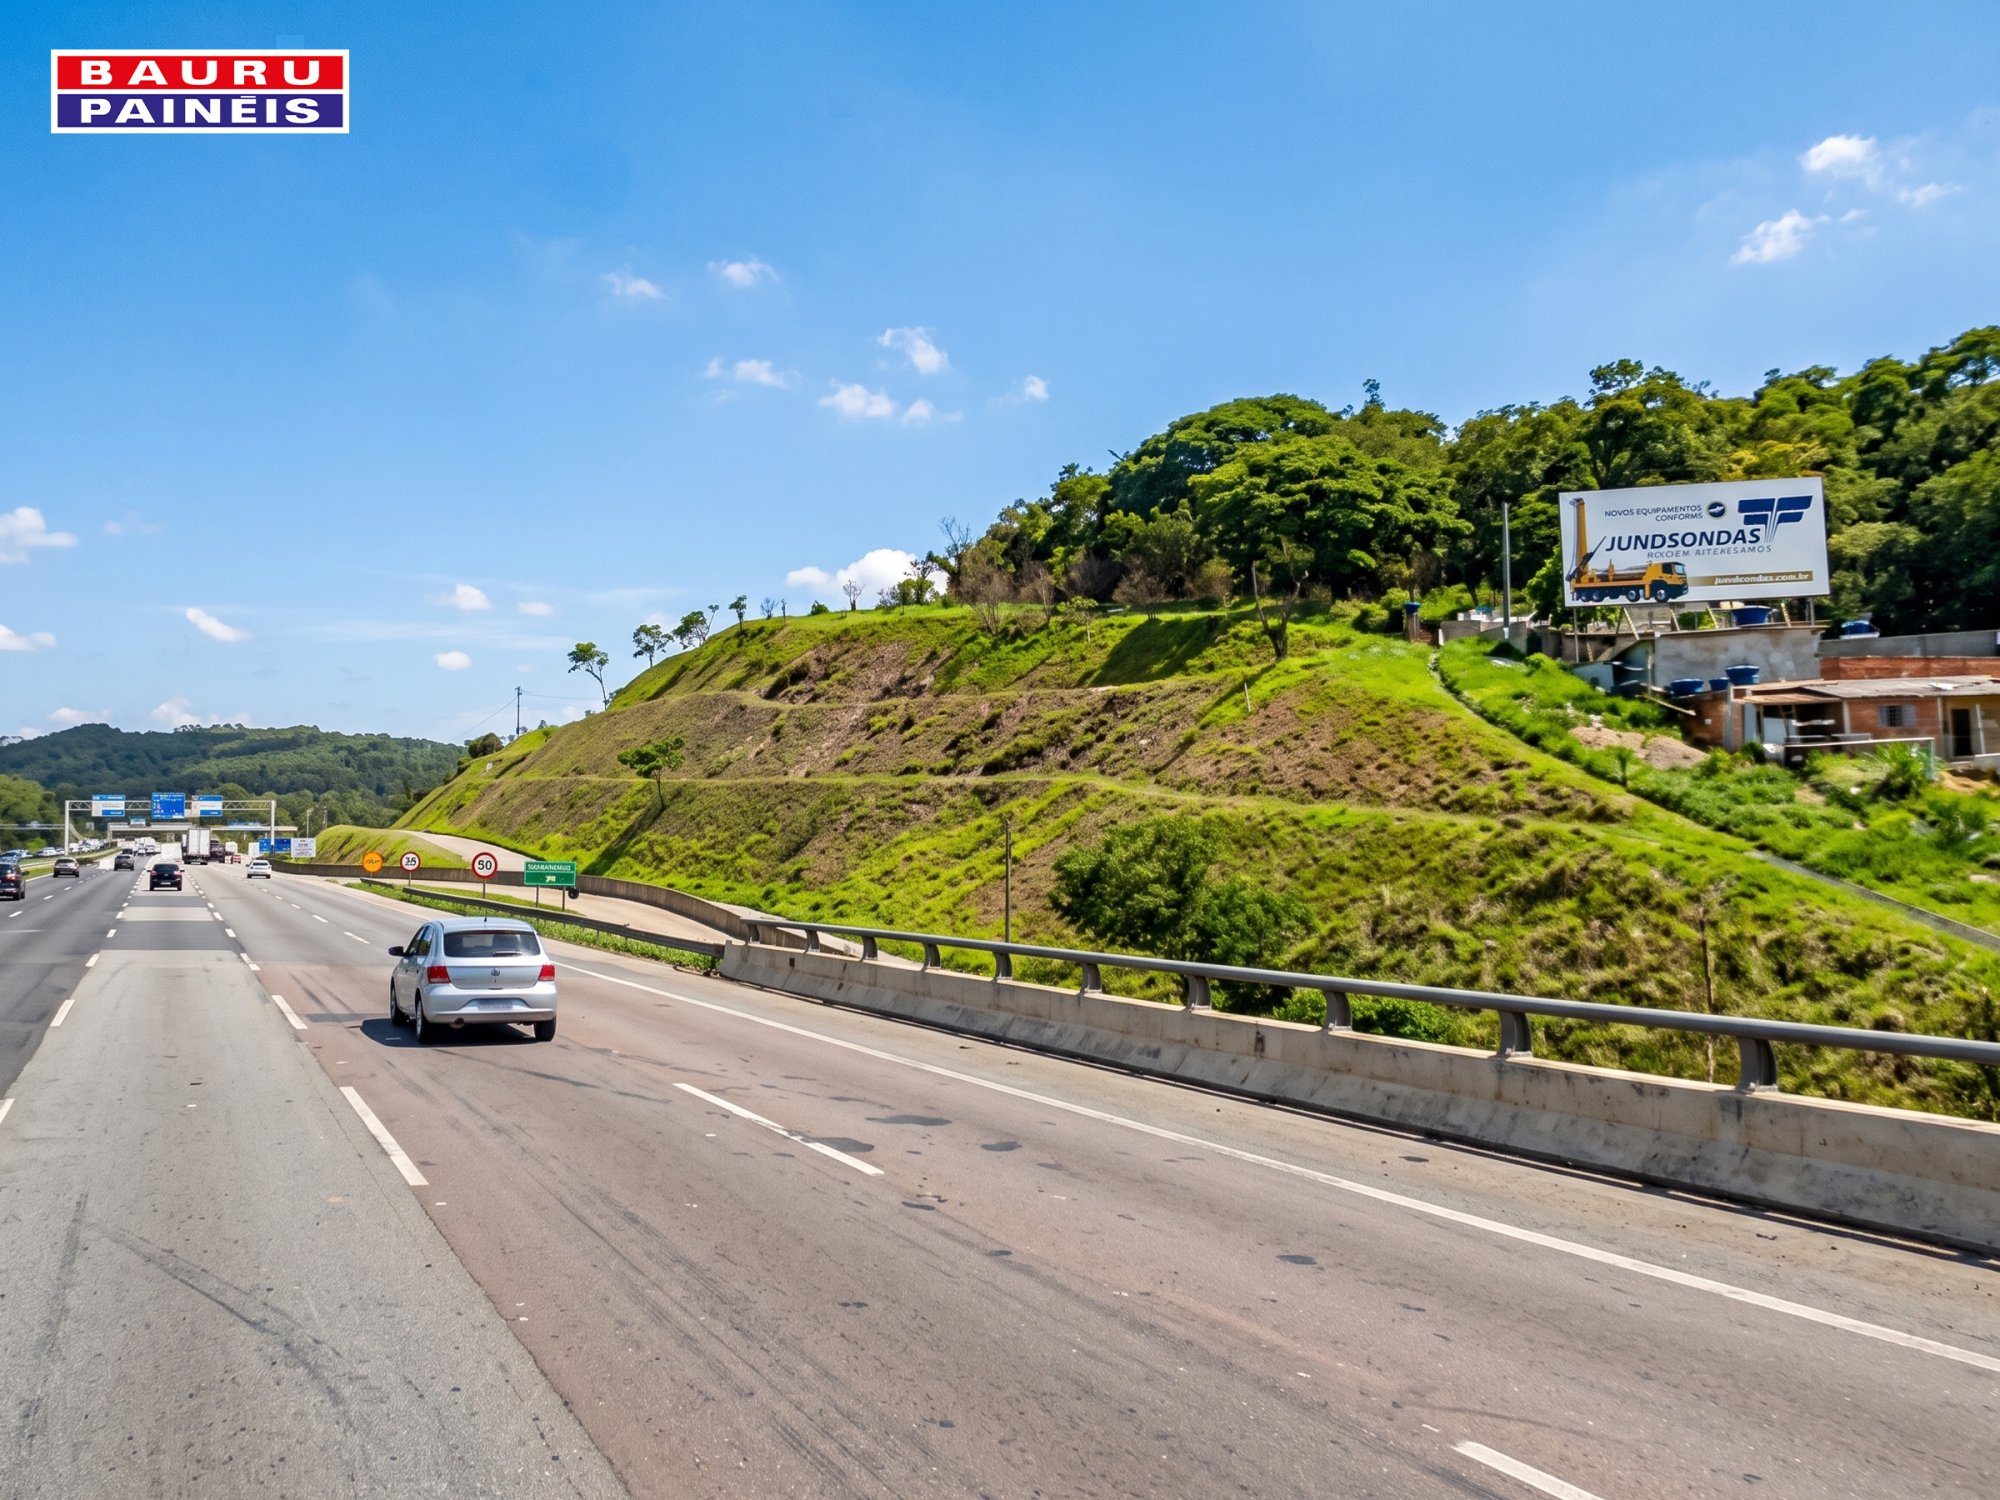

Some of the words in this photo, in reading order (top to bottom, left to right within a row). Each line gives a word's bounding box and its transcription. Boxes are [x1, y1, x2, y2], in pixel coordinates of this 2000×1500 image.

[1604, 508, 1635, 517] NOVOS
[1635, 504, 1703, 516] EQUIPAMENTOS
[1605, 528, 1761, 552] JUNDSONDAS
[477, 859, 493, 871] 50
